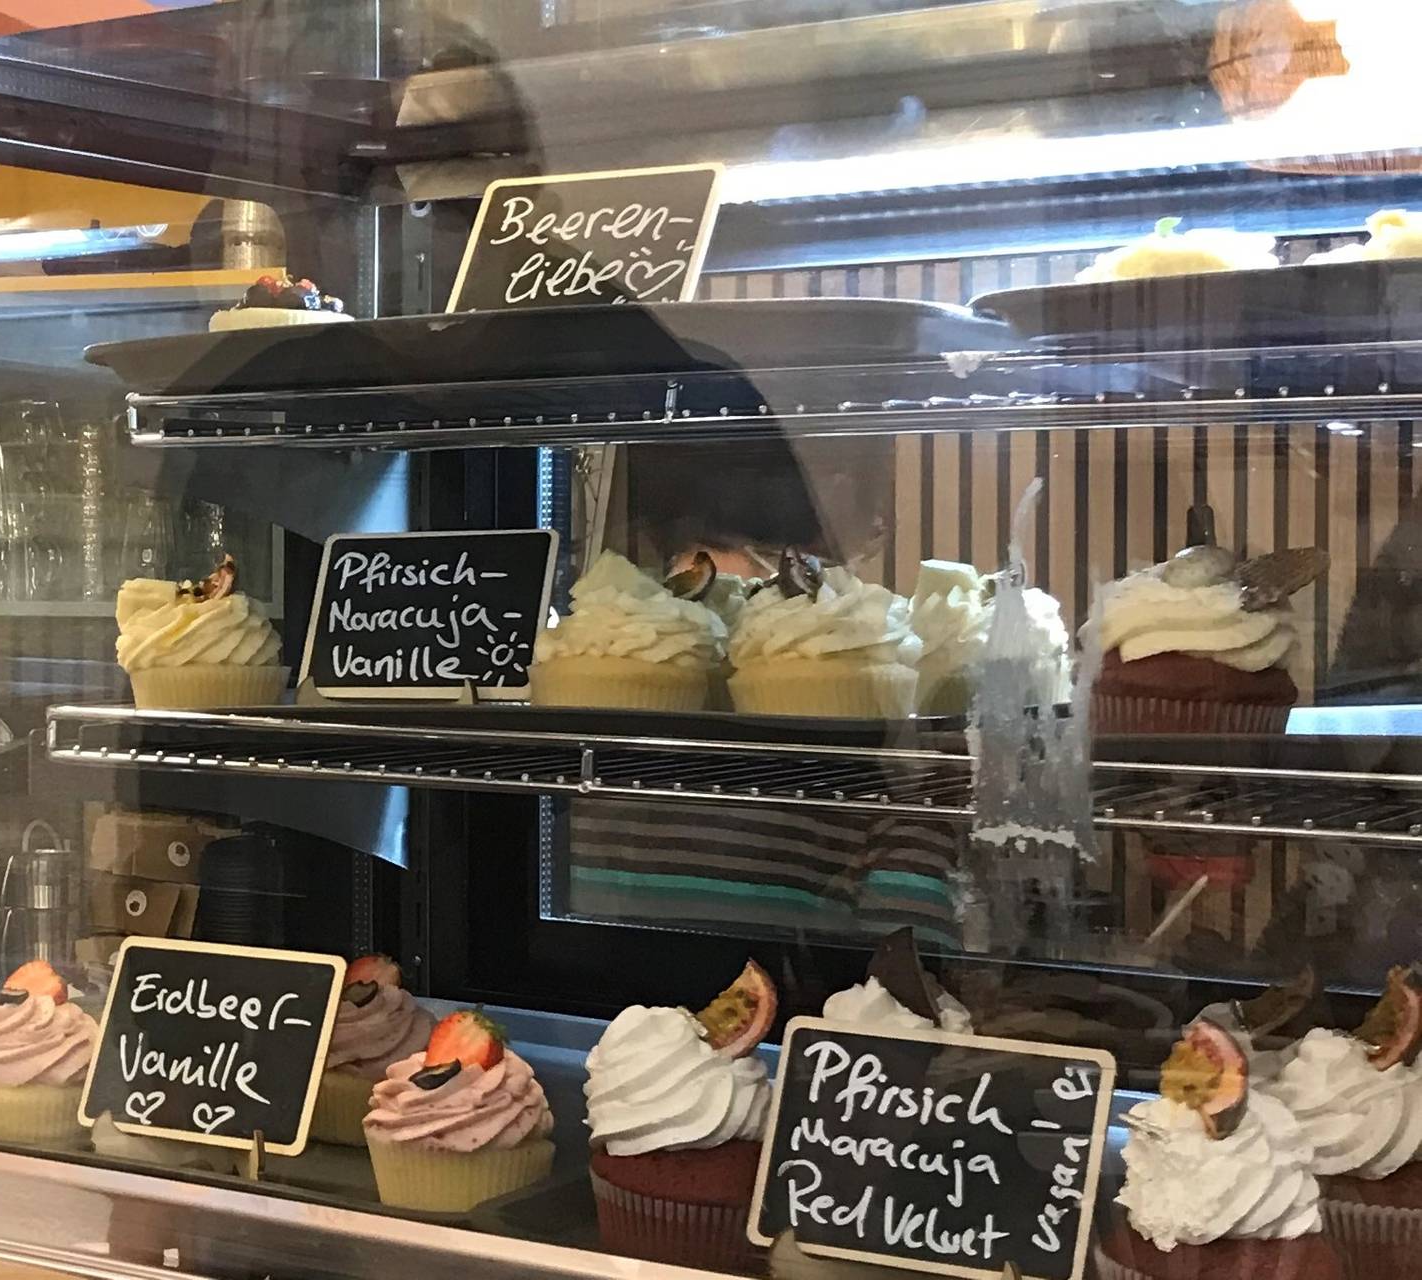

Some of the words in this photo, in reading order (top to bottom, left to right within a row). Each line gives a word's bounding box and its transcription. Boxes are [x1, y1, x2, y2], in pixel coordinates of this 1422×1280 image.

[490, 196, 694, 245] Beeren-
[334, 551, 508, 593] Pfirsich-
[332, 644, 480, 682] Vanille
[130, 973, 312, 1031] Erdbeer-
[119, 1032, 271, 1106] Vanille
[803, 1040, 1013, 1135] Pfirsich
[790, 1116, 1000, 1207] Maracuja
[778, 1158, 874, 1238] Red
